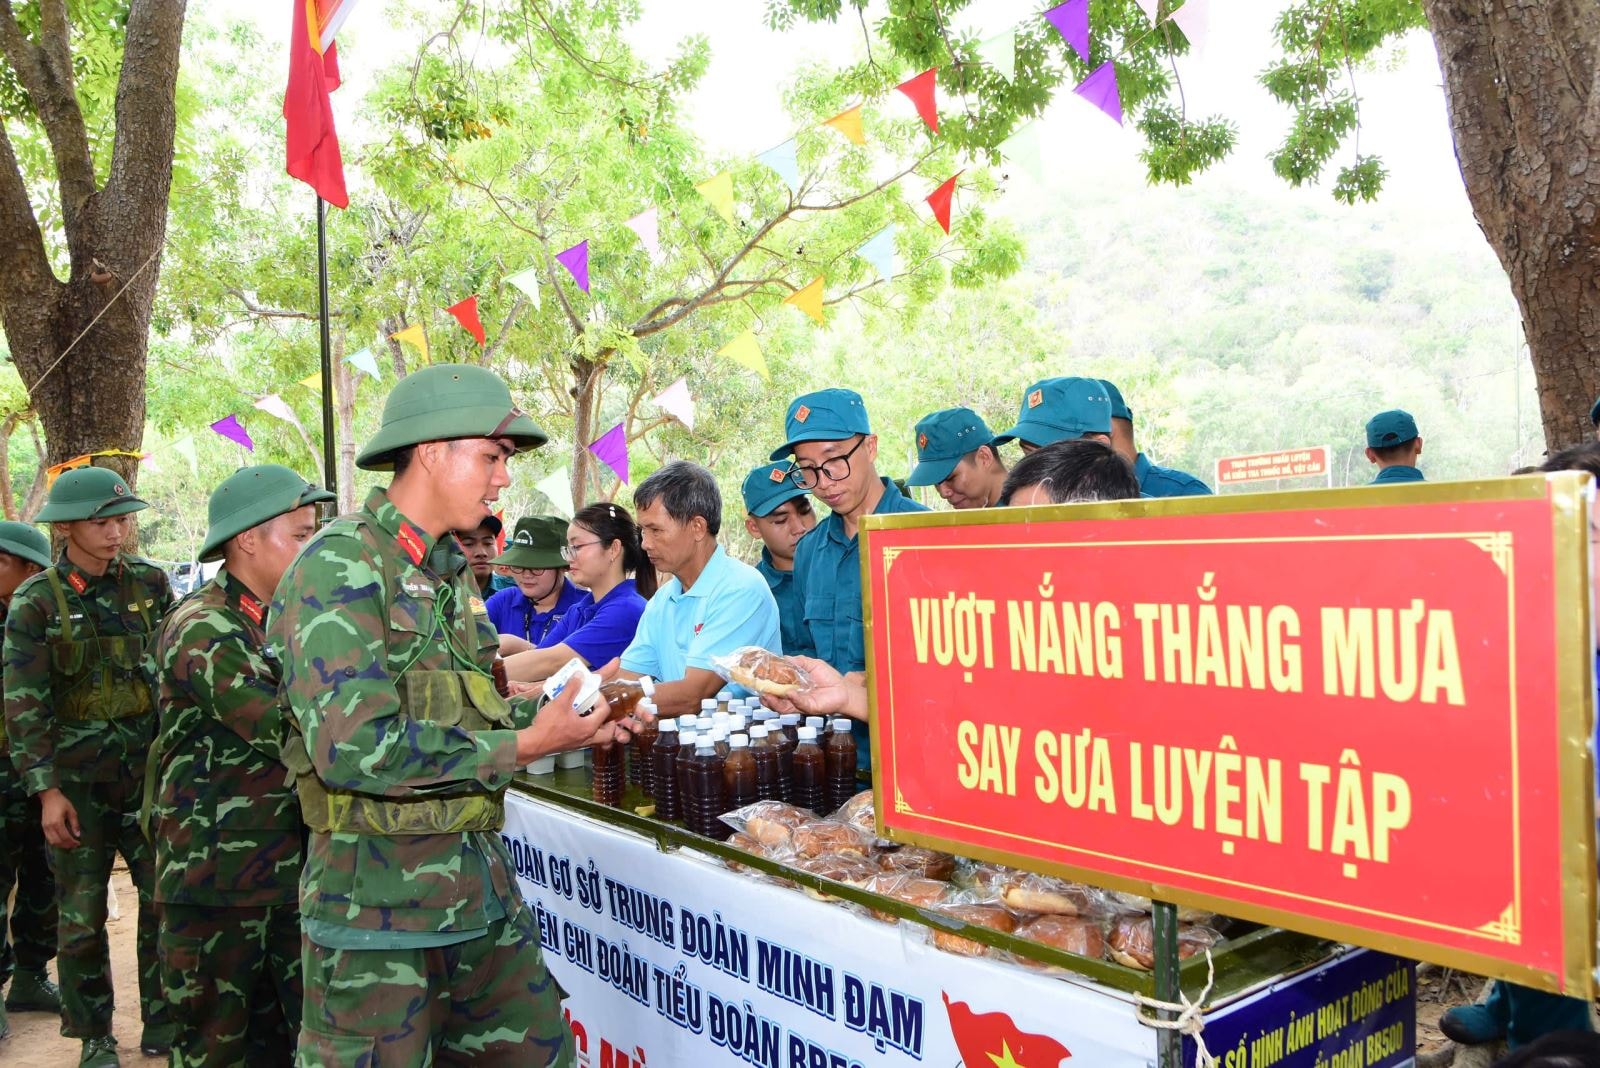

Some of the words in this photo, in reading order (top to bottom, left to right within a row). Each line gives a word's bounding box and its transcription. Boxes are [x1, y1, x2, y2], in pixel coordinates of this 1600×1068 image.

[910, 592, 996, 682] VƯỢT
[1007, 572, 1124, 680] NẮNG
[1134, 572, 1302, 694] THẮNG
[1321, 598, 1467, 706] MƯA
[956, 718, 1022, 796] SAY
[1034, 727, 1117, 815] SƯA
[1129, 735, 1287, 854] LUYỆN
[1299, 748, 1413, 879] TẬP
[548, 853, 574, 900] CƠ
[575, 856, 604, 914] SỞ
[605, 876, 676, 950] TRUNG
[680, 905, 750, 983] ĐOÀN
[757, 938, 837, 1021] MINH
[843, 971, 925, 1061] ĐẠM
[563, 918, 596, 974] CHI
[596, 933, 651, 1008] ĐOÀN
[652, 960, 704, 1035] TIỂU
[707, 991, 781, 1068] ĐOÀN
[1251, 1026, 1284, 1068] HÌNH
[1286, 1011, 1314, 1056] ẢNH
[1317, 995, 1349, 1041] HOẠT
[1352, 979, 1384, 1025] ĐỘNG
[1386, 961, 1409, 1005] CỦA
[1366, 1022, 1403, 1067] BB500
